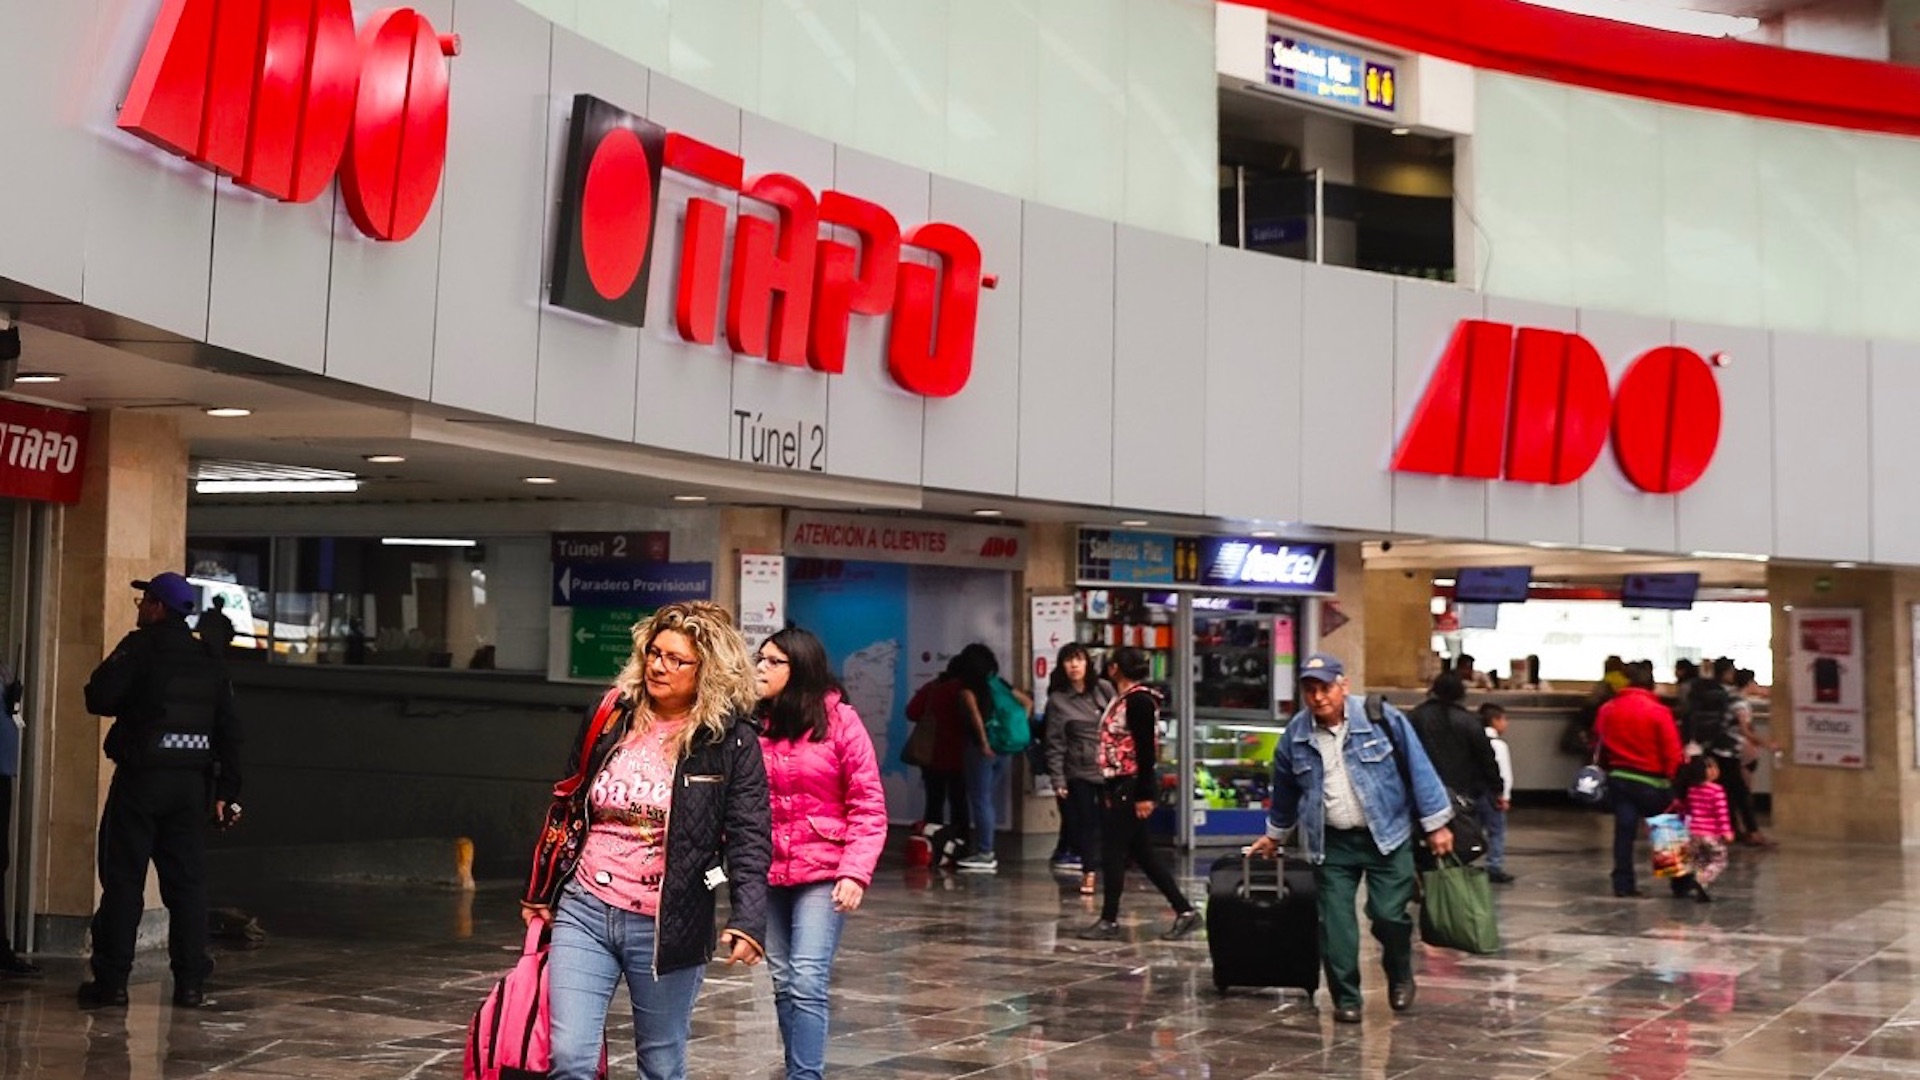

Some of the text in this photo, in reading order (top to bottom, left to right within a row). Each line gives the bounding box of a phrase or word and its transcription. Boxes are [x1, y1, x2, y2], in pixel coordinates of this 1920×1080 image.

[662, 131, 982, 398] TAPO
[1389, 319, 1722, 494] ADO
[8, 424, 78, 474] TAPO
[734, 410, 824, 471] Túnel 2
[612, 535, 627, 557] 2
[867, 528, 877, 548] A
[882, 529, 946, 552] CLIENTES
[979, 537, 1018, 558] ADO
[571, 577, 706, 592] Paradero Provisional
